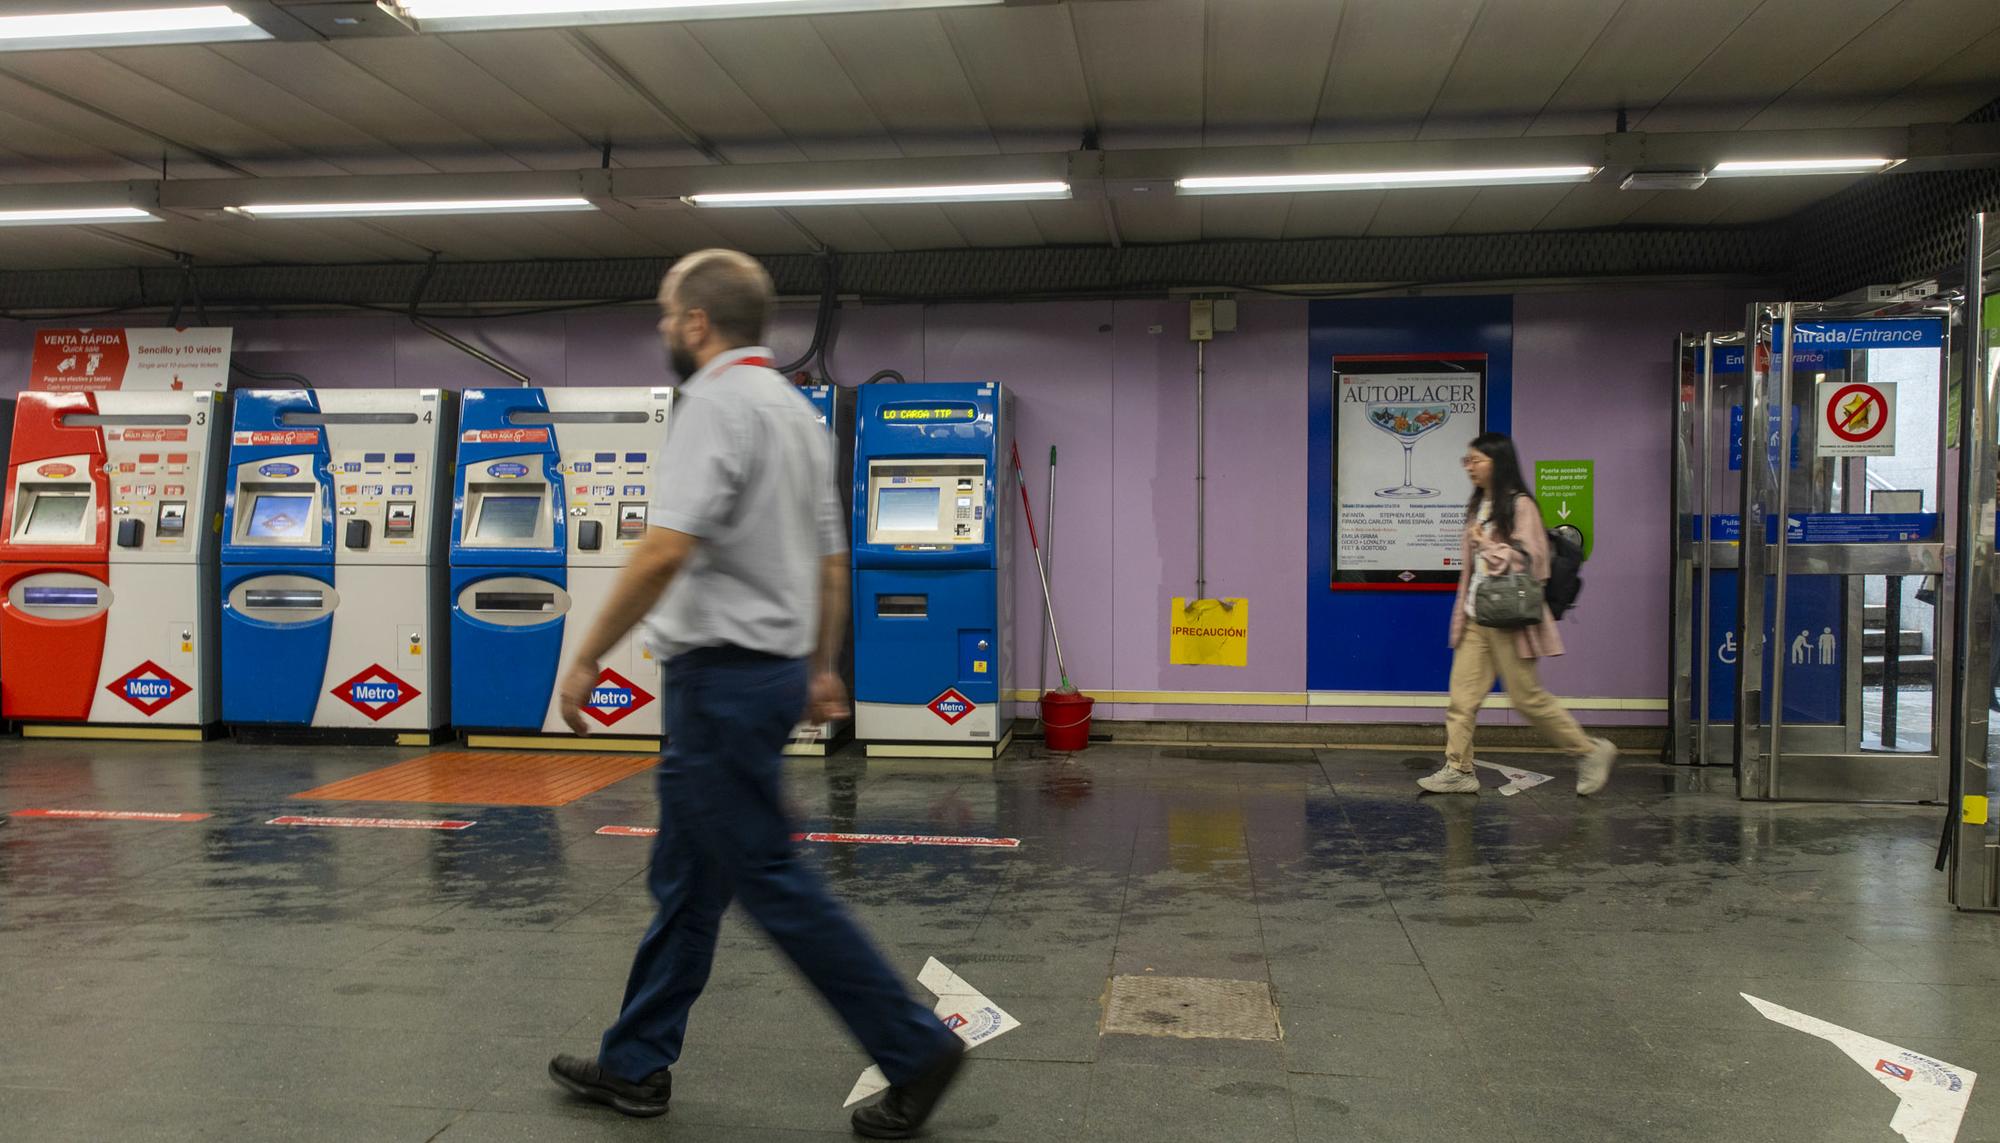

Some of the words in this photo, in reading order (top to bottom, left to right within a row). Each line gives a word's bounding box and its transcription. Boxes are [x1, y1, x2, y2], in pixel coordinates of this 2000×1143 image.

[44, 335, 77, 344] VENTA
[81, 333, 120, 344] RÁPIDA
[1793, 328, 1922, 344] ntrada/Entrance
[138, 345, 173, 354] Sencillo
[175, 347, 181, 355] y
[184, 345, 194, 354] 10
[196, 345, 222, 355] viajes
[1344, 385, 1475, 402] AUTOPLACER
[1450, 402, 1476, 414] 2023
[196, 412, 206, 425] 3
[423, 410, 432, 424] 4
[655, 409, 665, 423] 5
[1172, 627, 1246, 638] ¡PRECAUCIÓN!
[130, 681, 168, 696] Metro
[356, 685, 396, 700] Metro
[588, 690, 629, 704] Metro
[940, 702, 964, 712] Metro
